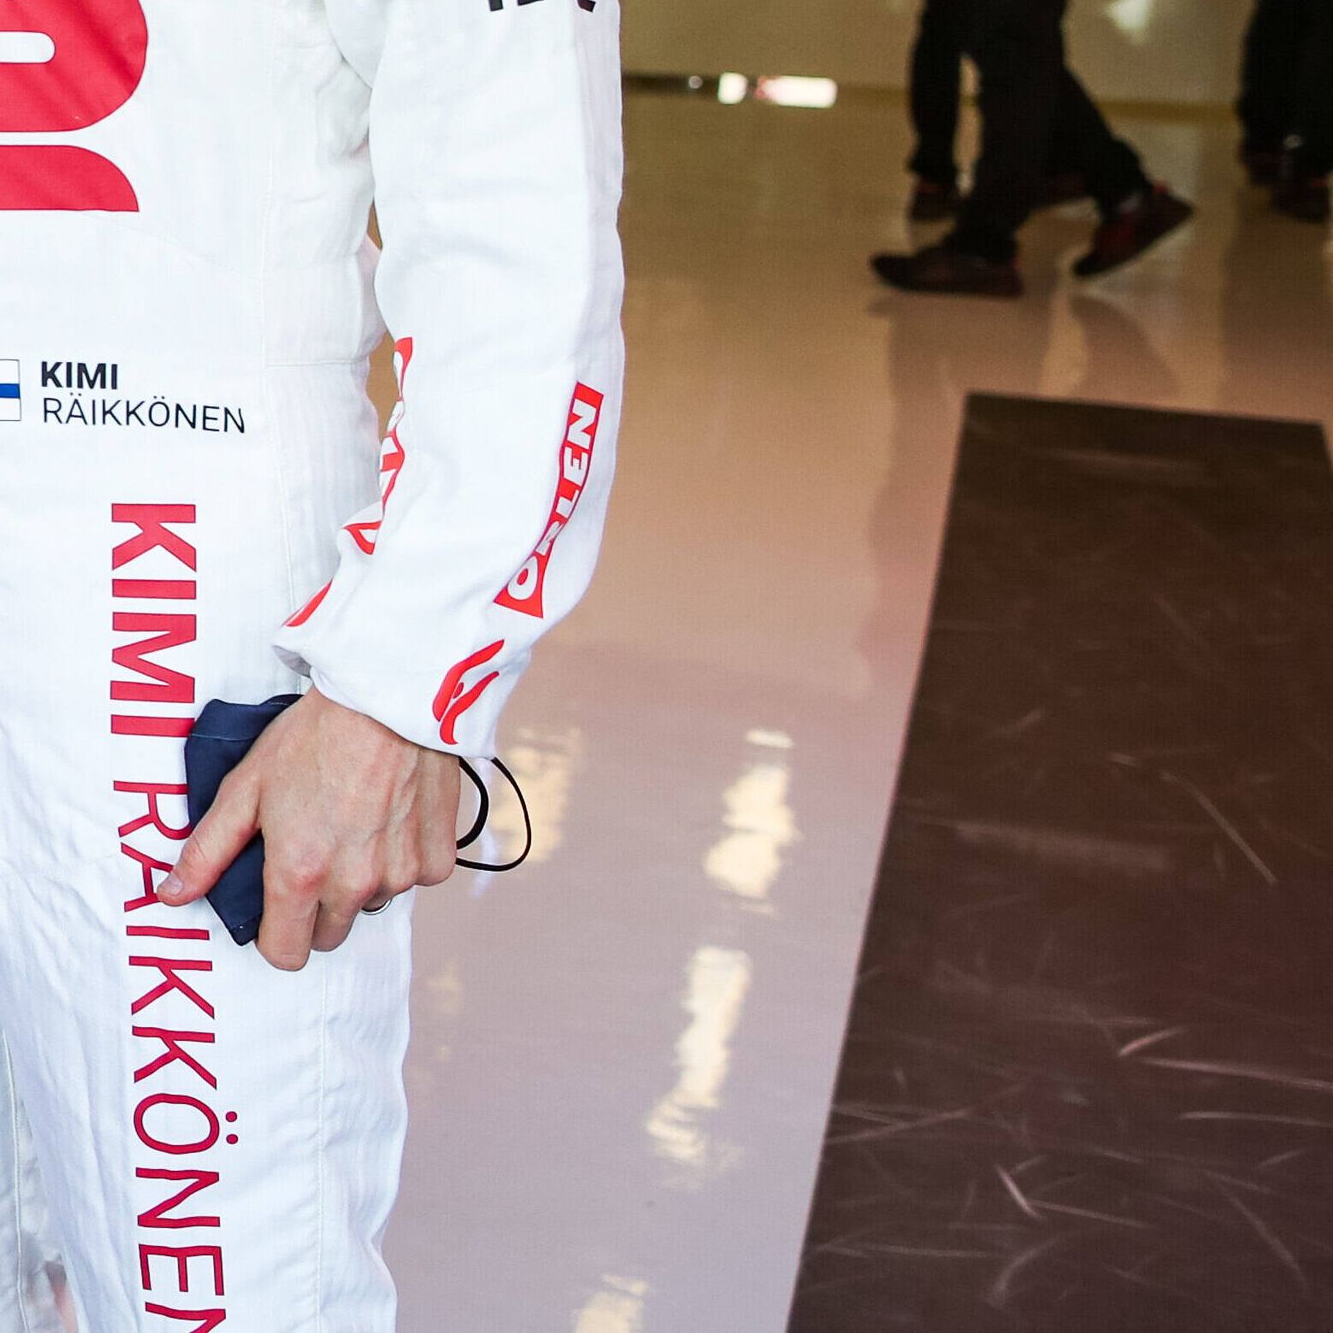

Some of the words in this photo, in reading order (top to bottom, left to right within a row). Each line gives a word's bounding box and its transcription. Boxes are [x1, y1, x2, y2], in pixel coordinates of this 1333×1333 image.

[40, 360, 120, 391] KIMI
[43, 394, 245, 435] RÄIKKÖNEN
[507, 398, 598, 601] ORLEN
[110, 502, 197, 738] KIMI
